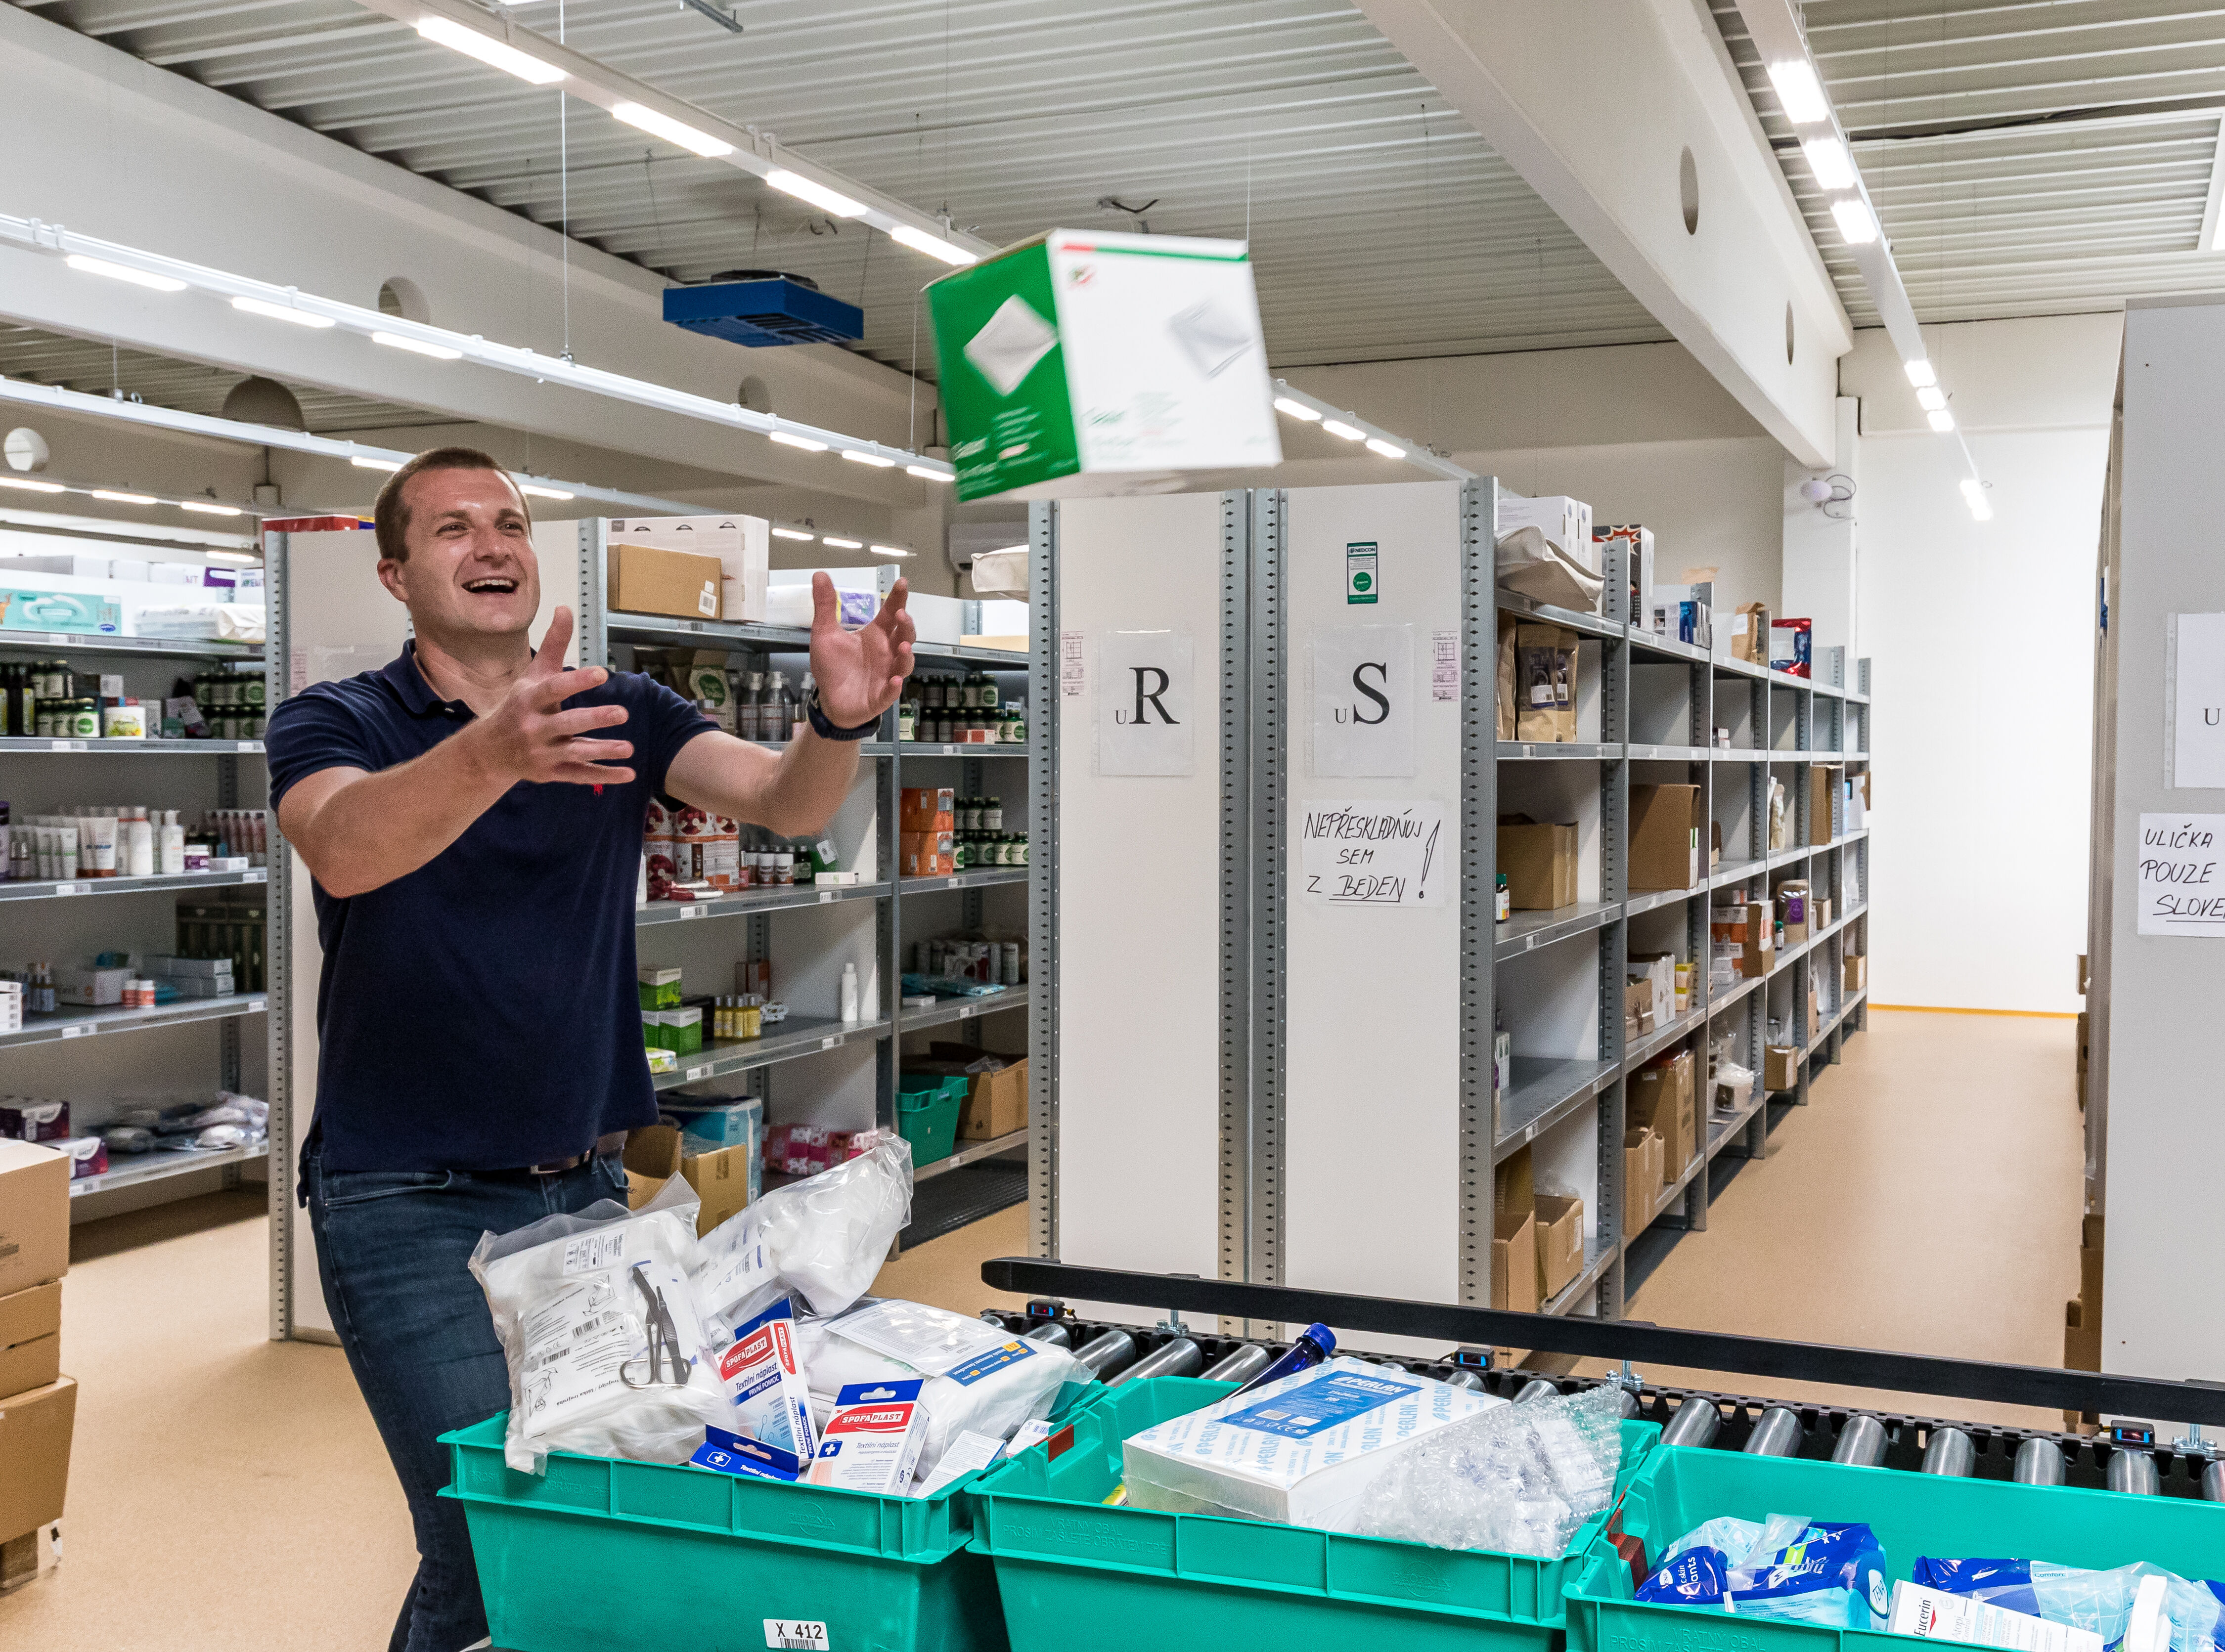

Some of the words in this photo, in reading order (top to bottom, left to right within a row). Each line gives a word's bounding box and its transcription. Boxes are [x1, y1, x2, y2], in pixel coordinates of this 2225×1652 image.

[1129, 666, 1180, 725] R
[1352, 662, 1390, 725] S
[2203, 707, 2221, 726] U
[2145, 823, 2214, 849] ULIČKA
[1336, 849, 1374, 864] SEM
[2140, 859, 2217, 884] POUZE
[1307, 875, 1322, 893] Z
[1332, 875, 1406, 900] BEDEN
[735, 1373, 755, 1391] Textilní
[756, 1362, 778, 1380] náplast
[748, 1384, 762, 1397] PRVNÍ
[762, 1375, 780, 1389] POMOC
[1351, 1377, 1407, 1393] PERLAN
[790, 1396, 800, 1425] náplast
[801, 1416, 810, 1436] POMOC
[795, 1428, 806, 1455] Textilní
[1688, 1557, 1699, 1582] ants
[1872, 1579, 1885, 1605] TENA
[775, 1622, 786, 1637] X
[795, 1624, 823, 1639] 412
[1914, 1600, 1931, 1637] Eucerin
[1952, 1615, 1963, 1640] Atopi
